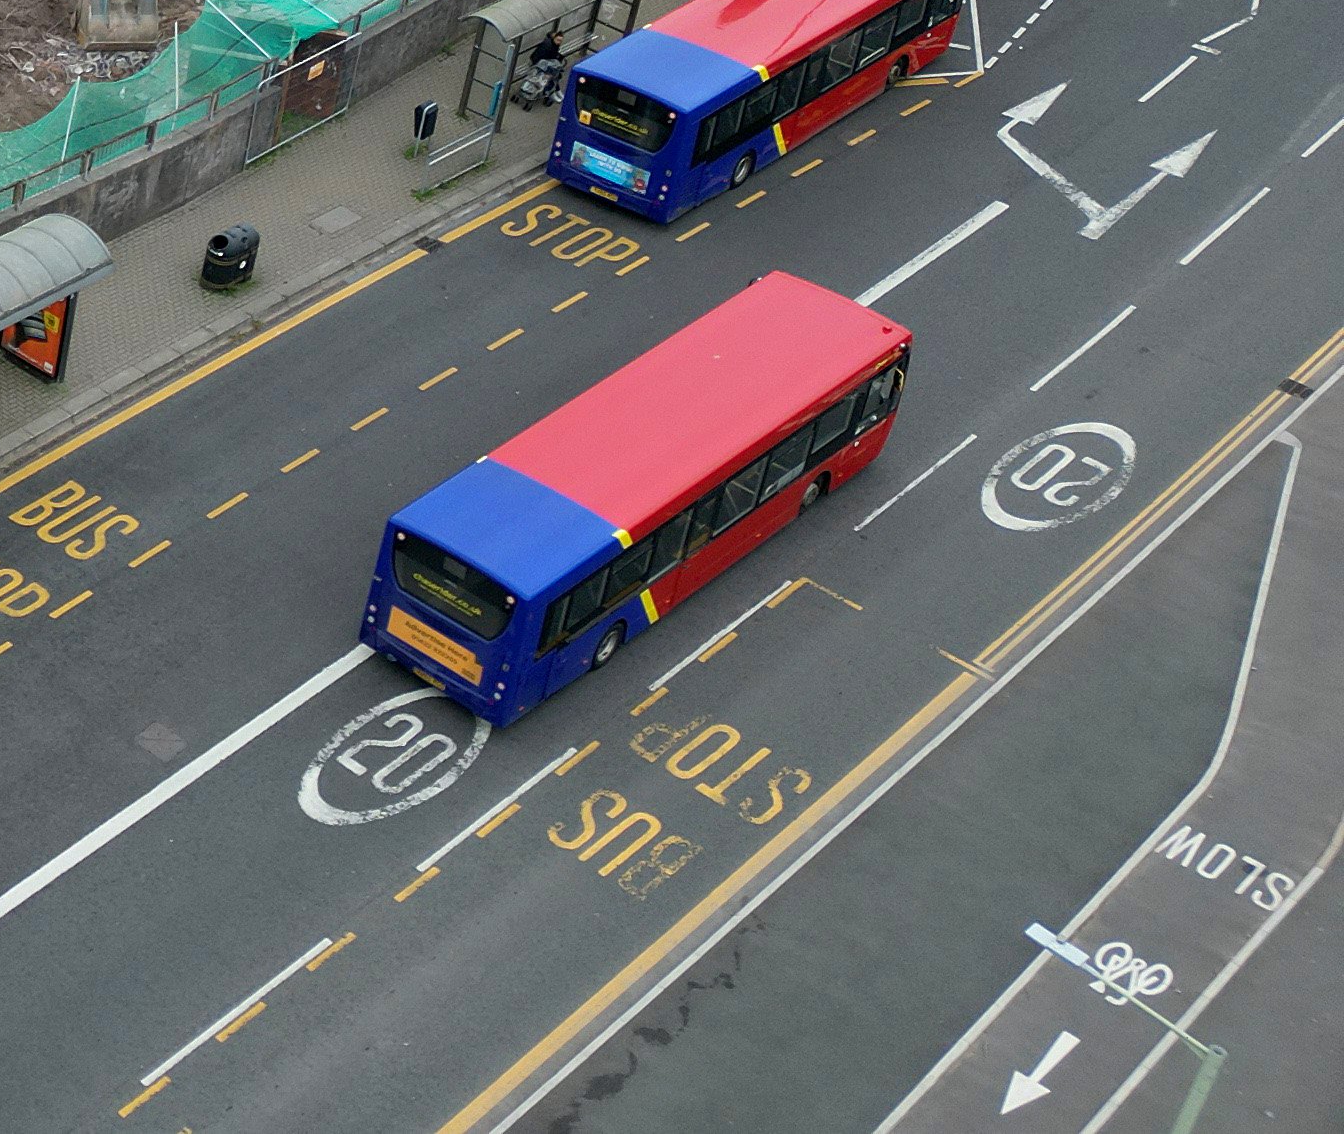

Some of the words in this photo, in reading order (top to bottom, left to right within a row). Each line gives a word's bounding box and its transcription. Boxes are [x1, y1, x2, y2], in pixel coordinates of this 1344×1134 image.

[500, 204, 641, 268] STOP
[1010, 443, 1114, 507] 20
[7, 480, 141, 561] BUS
[335, 713, 458, 795] 20
[628, 714, 813, 826] STOP
[546, 788, 705, 902] BUS
[1153, 824, 1297, 912] SLOW
